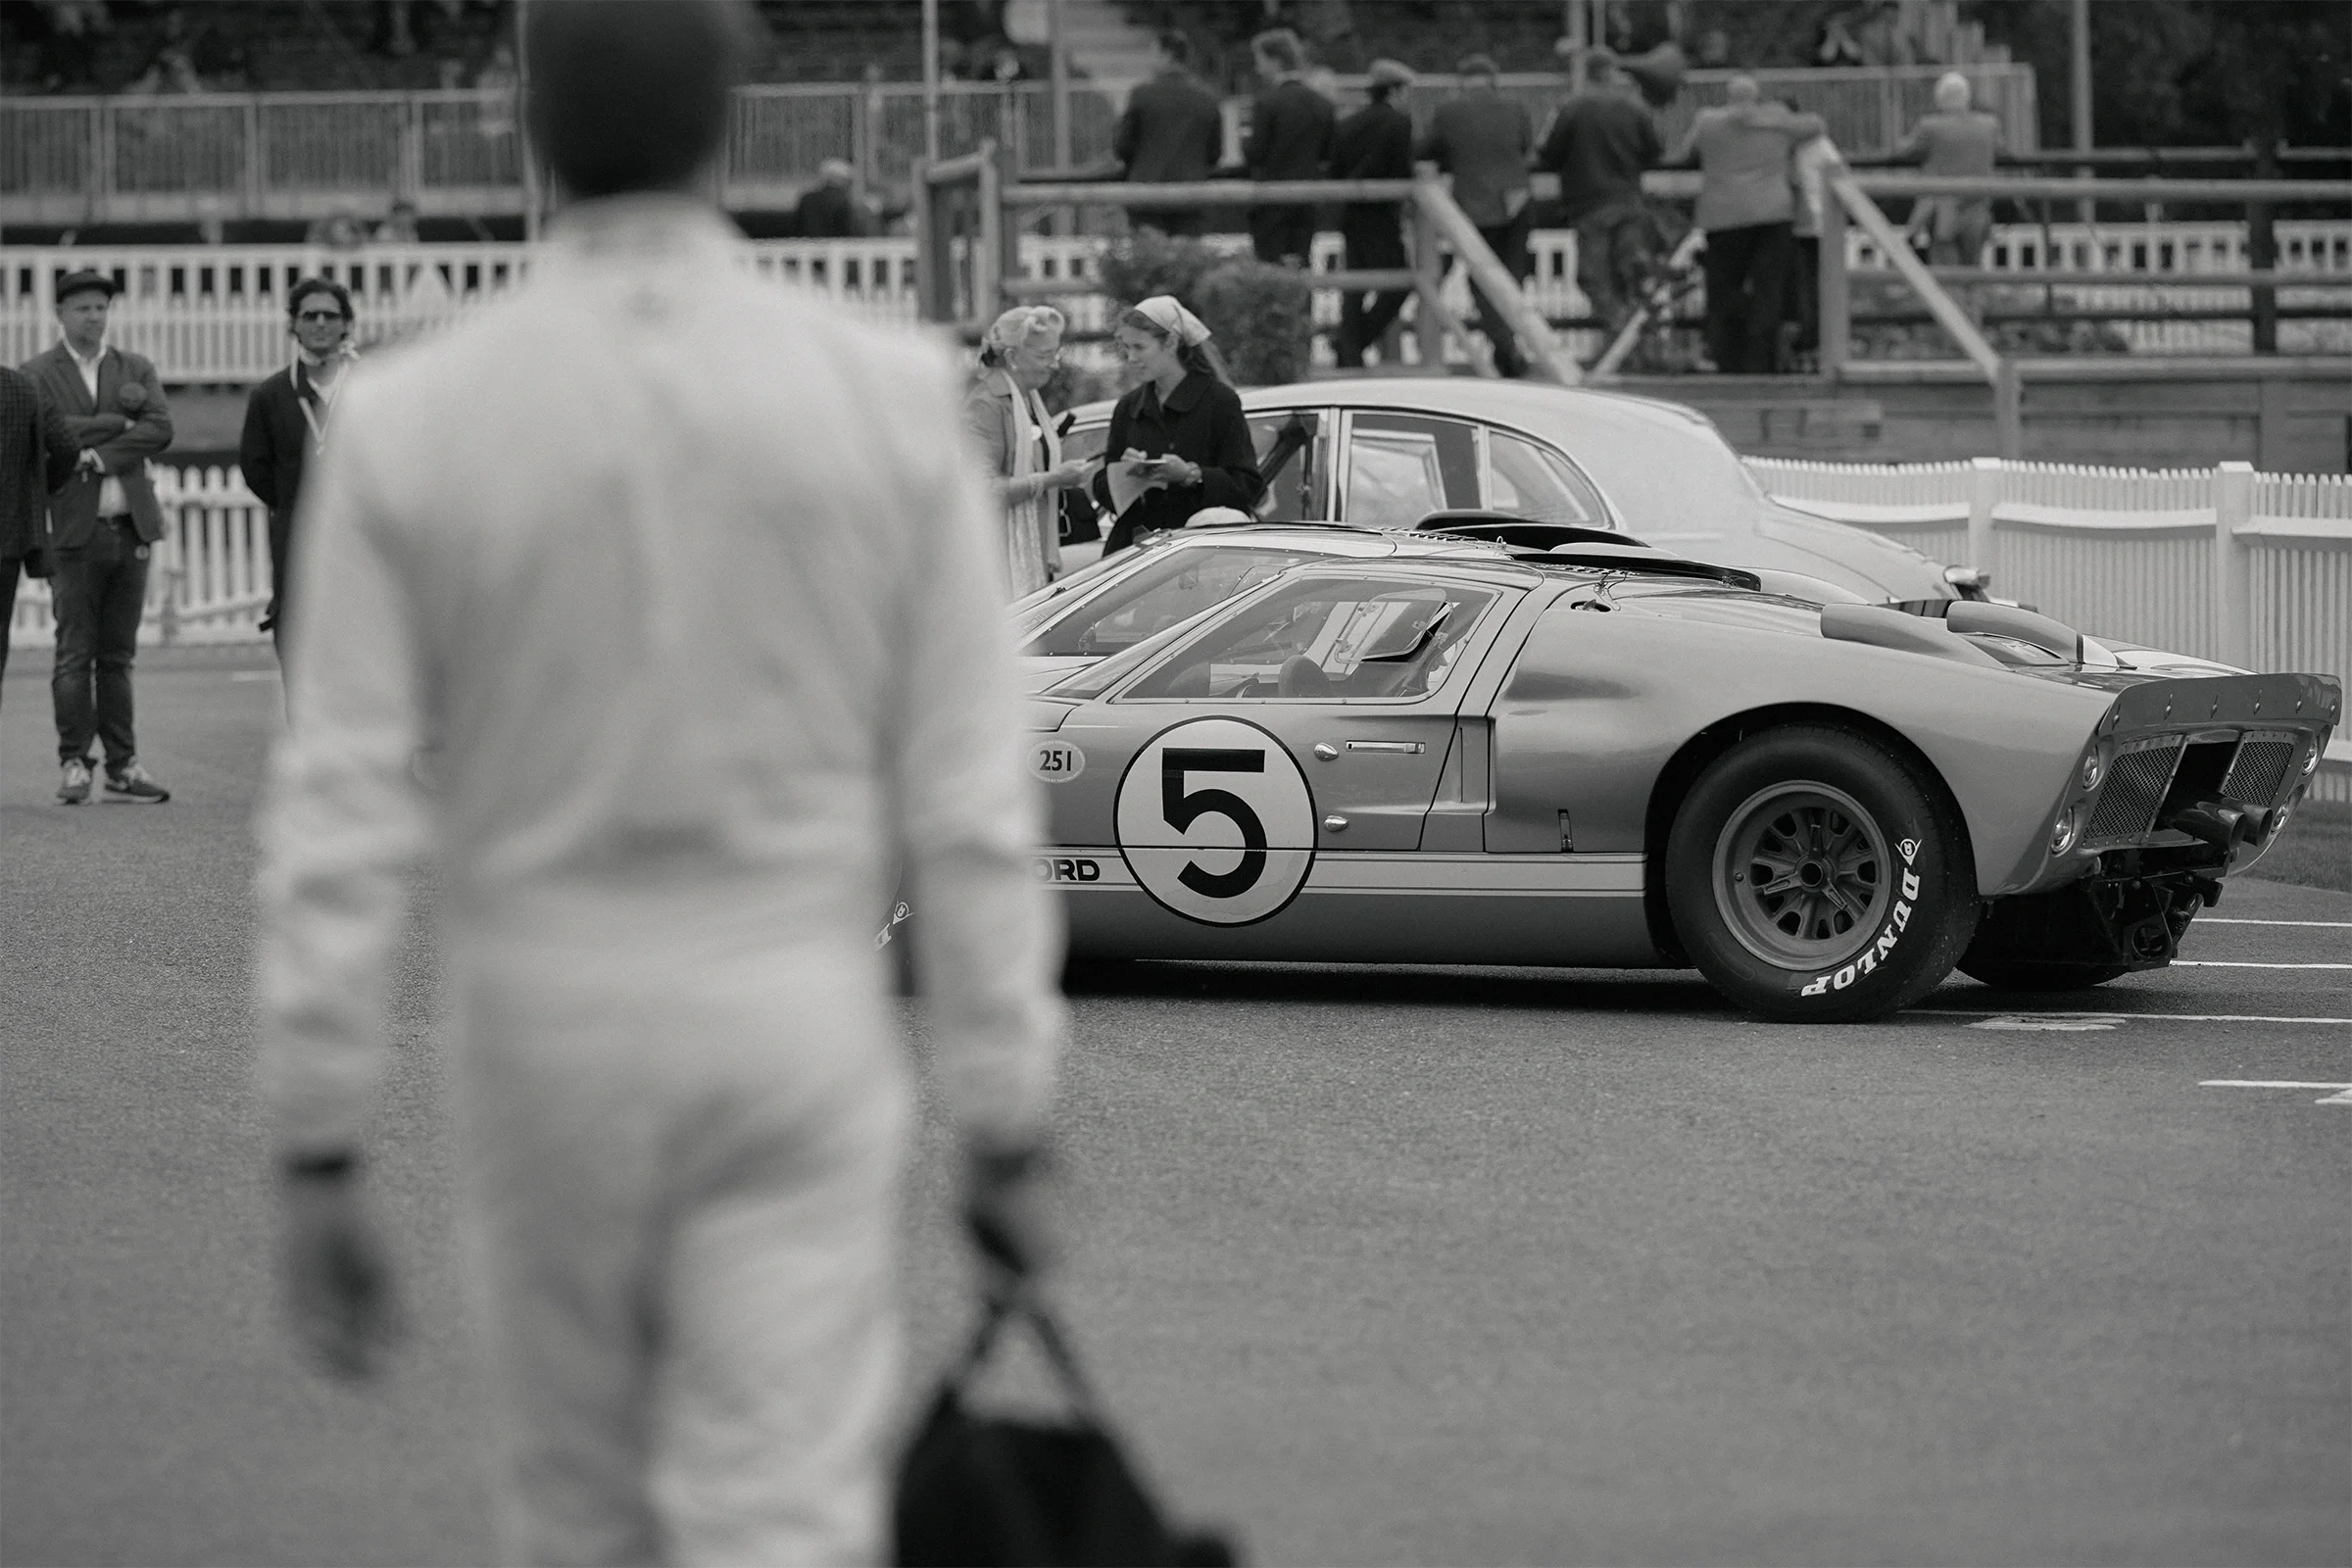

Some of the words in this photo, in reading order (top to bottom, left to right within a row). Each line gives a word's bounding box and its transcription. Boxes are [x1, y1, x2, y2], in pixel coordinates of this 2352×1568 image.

[1039, 750, 1071, 771] 251
[1162, 748, 1267, 899] 5
[1033, 858, 1100, 881] ORD
[1801, 867, 1920, 997] DUNLOP
